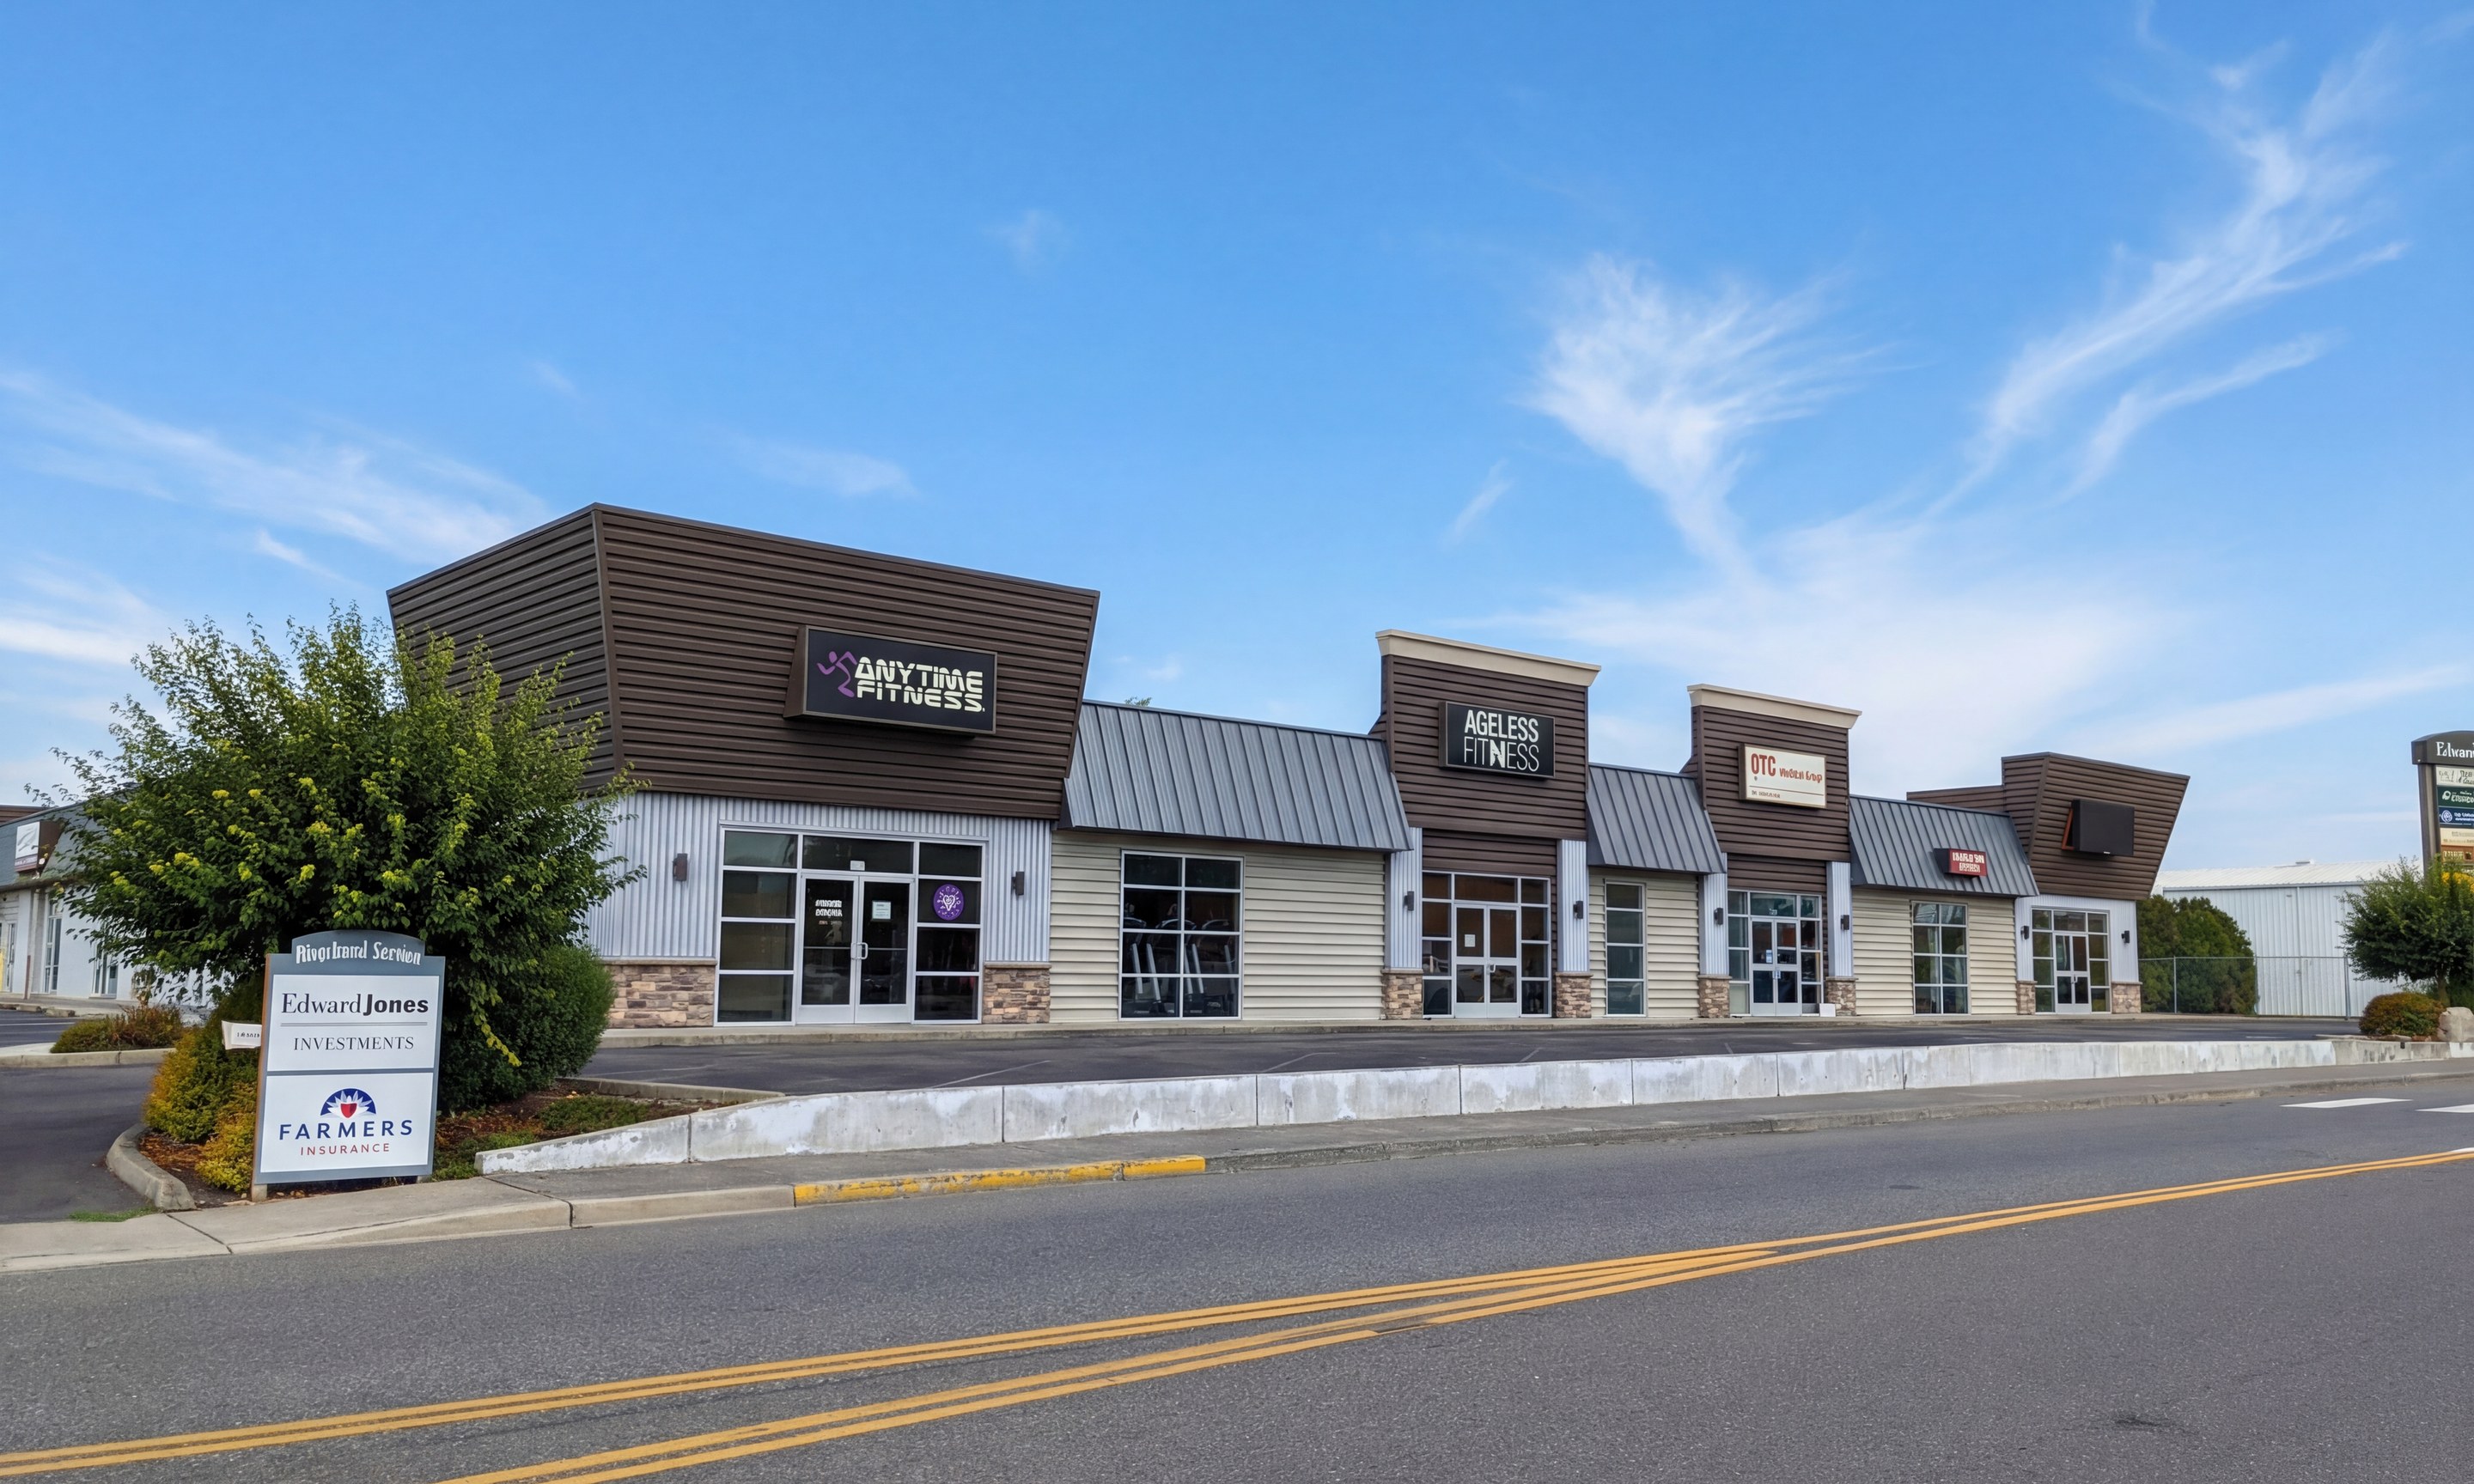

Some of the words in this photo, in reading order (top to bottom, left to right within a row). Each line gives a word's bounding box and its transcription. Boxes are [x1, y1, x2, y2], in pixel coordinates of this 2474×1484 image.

[855, 656, 984, 694] ANYTIME
[1464, 709, 1539, 743] AGELESS
[1464, 736, 1539, 772] FITNESS
[1751, 753, 1776, 776] OTC
[281, 993, 362, 1014] Edward
[363, 994, 429, 1017] Jones
[293, 1037, 415, 1051] INVESTMENTS
[279, 1119, 412, 1140] FARMERS
[300, 1143, 390, 1156] INSURANCE
